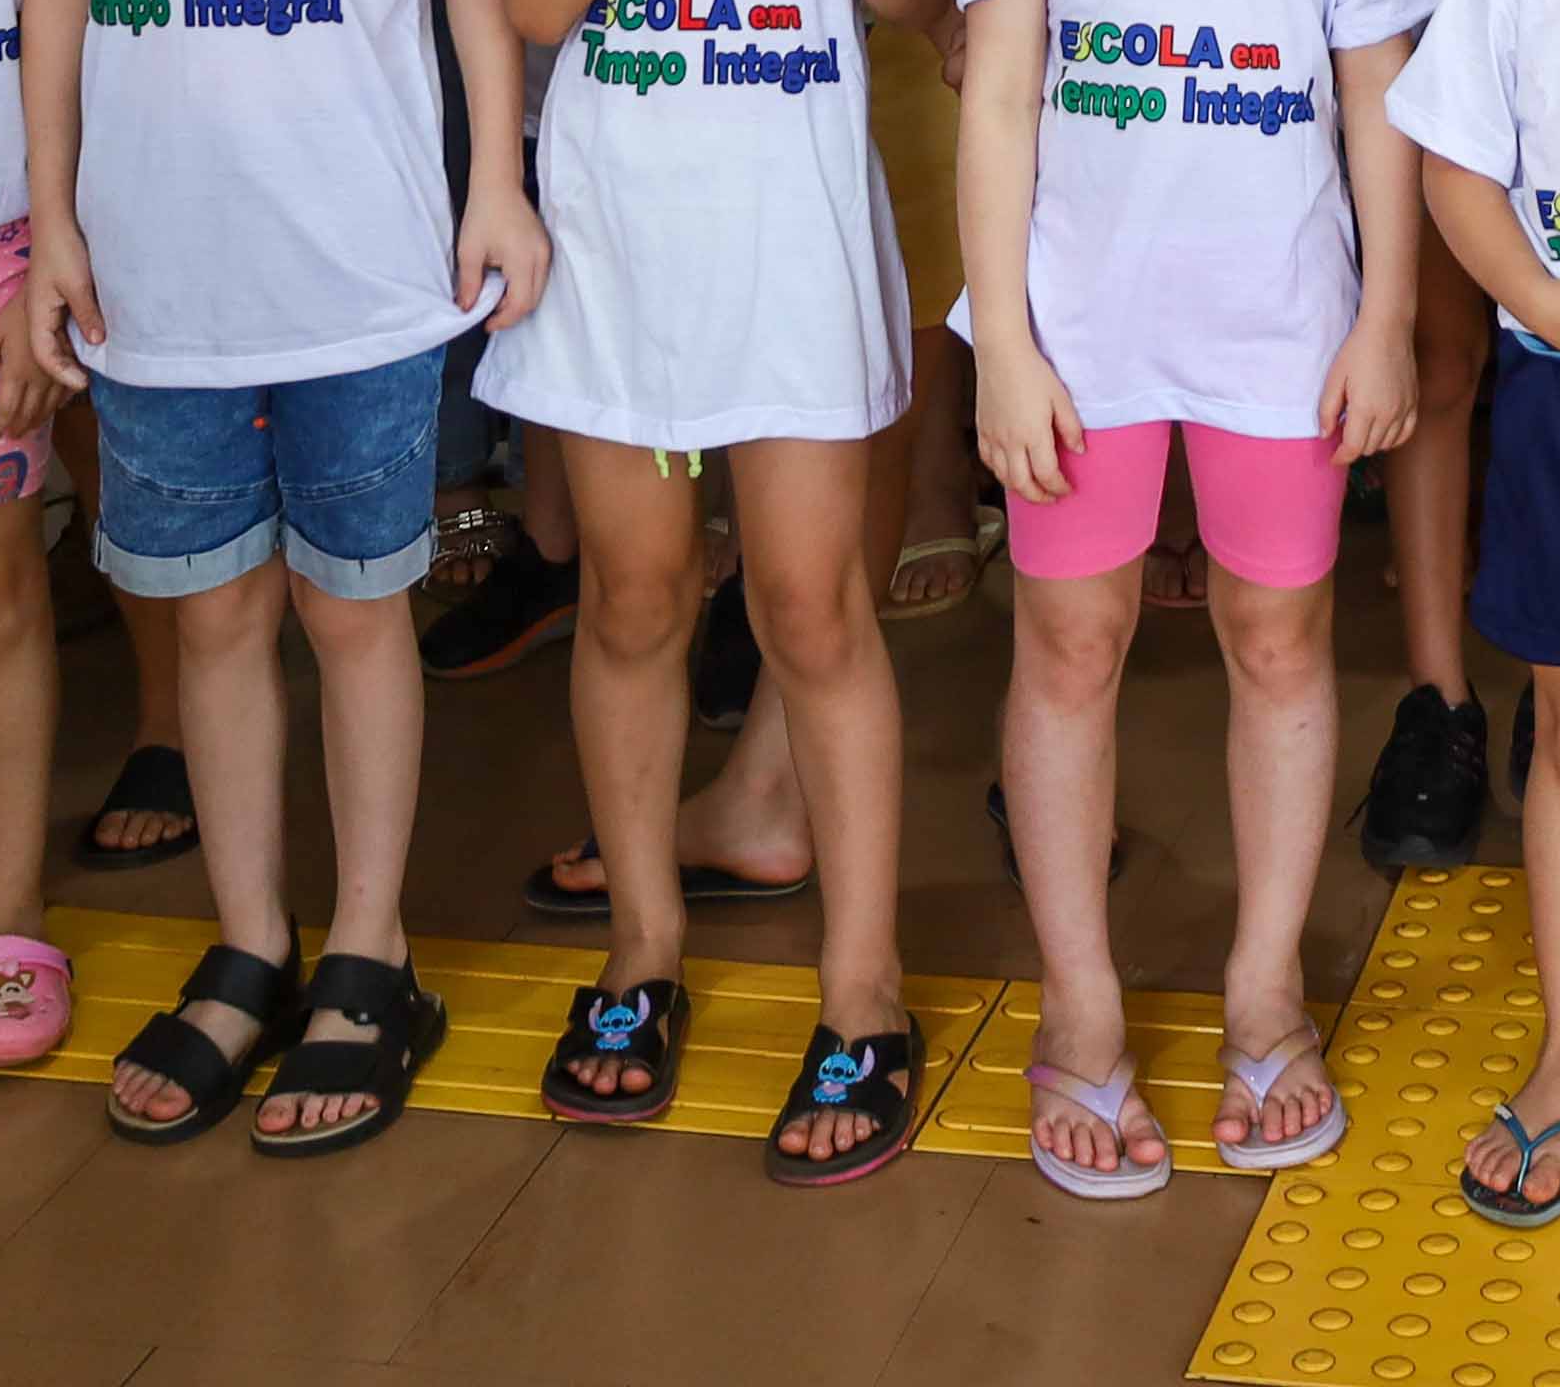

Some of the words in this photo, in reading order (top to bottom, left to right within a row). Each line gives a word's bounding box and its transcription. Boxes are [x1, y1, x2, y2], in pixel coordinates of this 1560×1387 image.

[748, 0, 801, 29] em
[702, 36, 840, 96] Integral
[1059, 19, 1223, 69] ESCOLA
[1231, 41, 1281, 70] em
